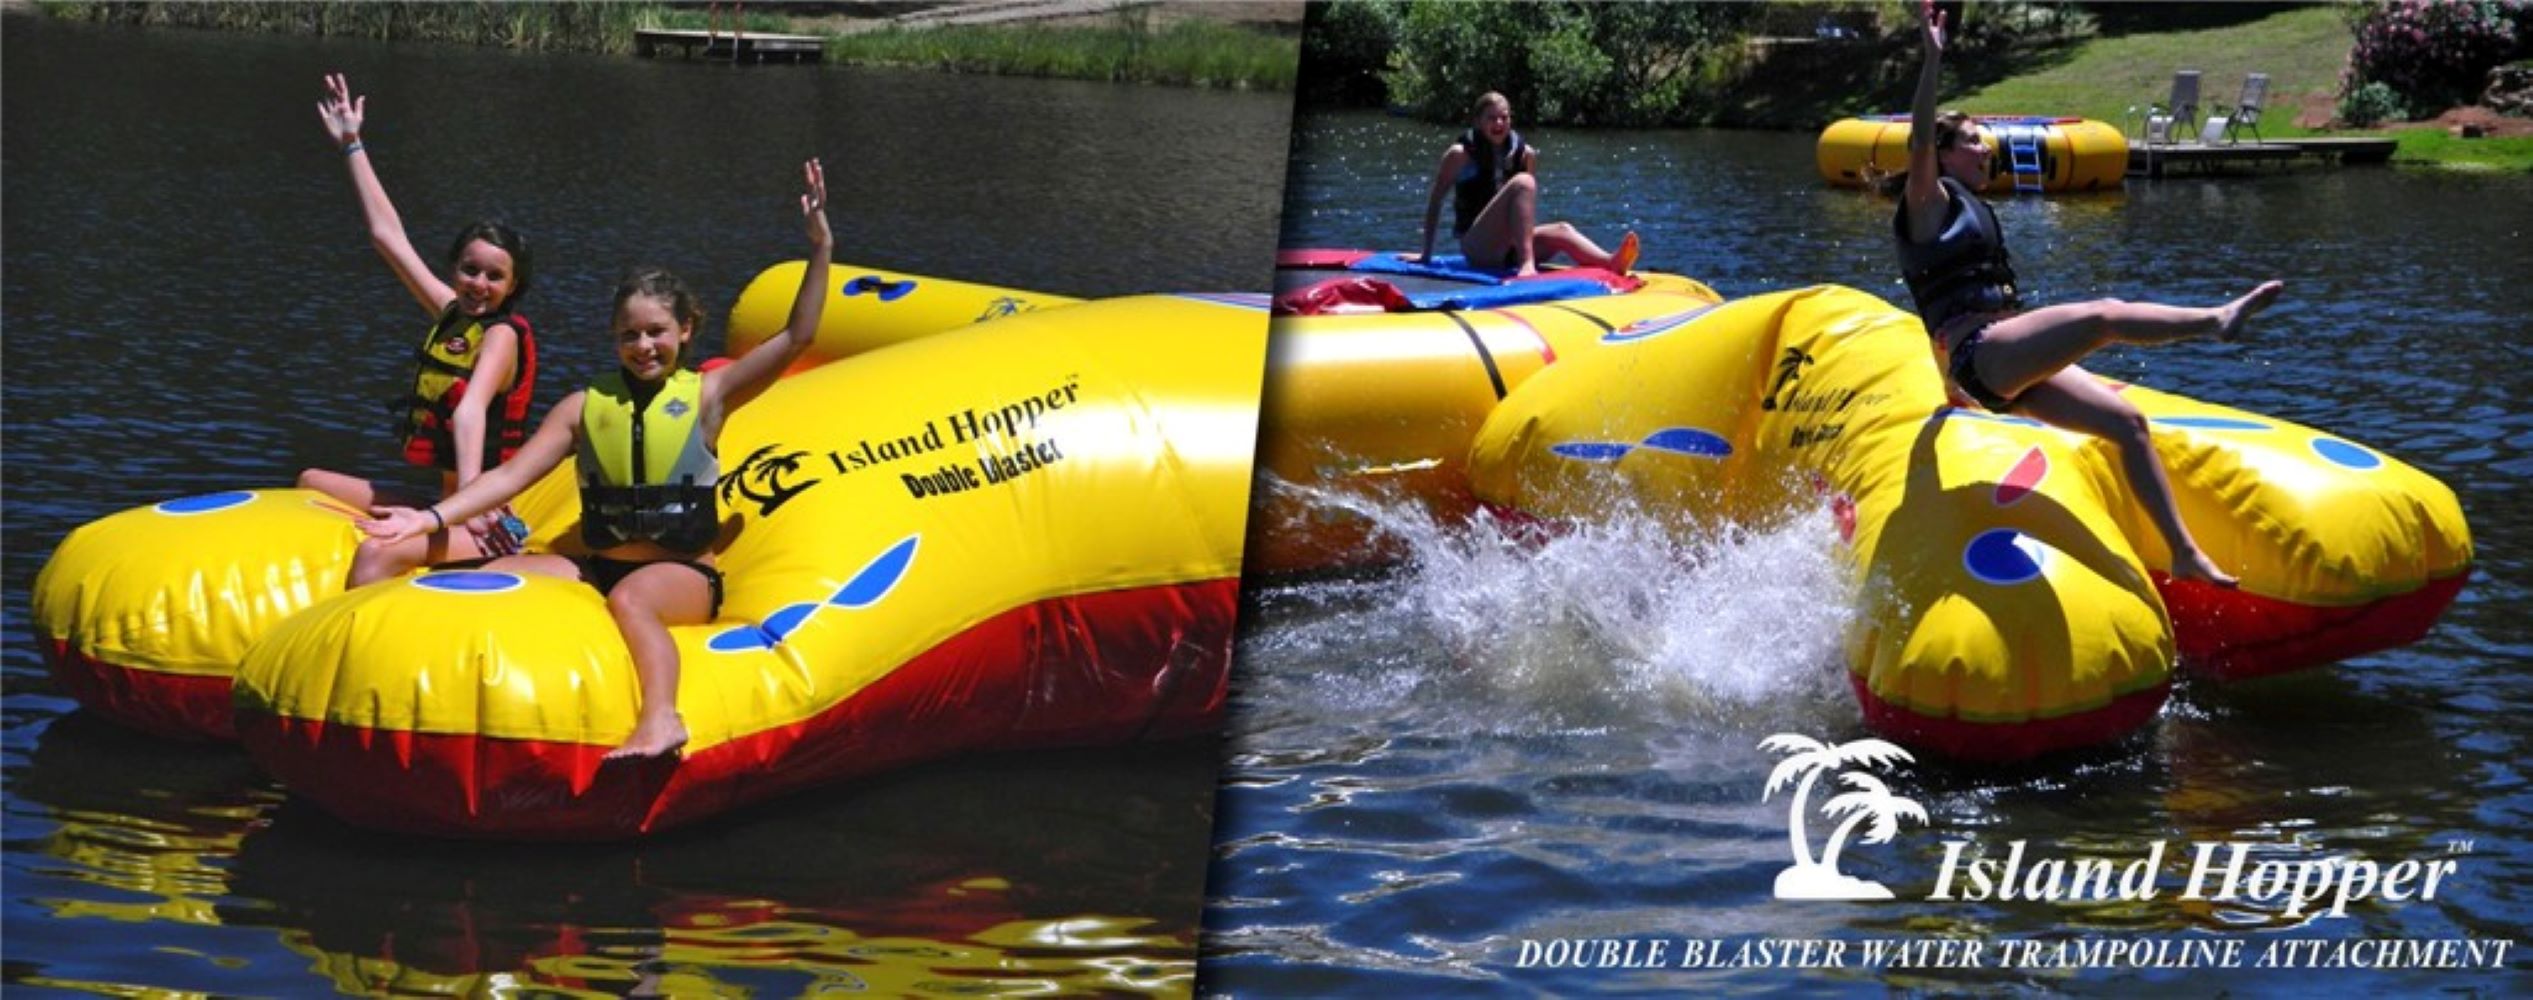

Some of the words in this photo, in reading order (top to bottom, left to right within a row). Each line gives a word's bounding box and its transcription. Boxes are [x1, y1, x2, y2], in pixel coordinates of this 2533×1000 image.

[828, 420, 945, 475] Island
[946, 381, 1080, 445] Hopper
[900, 463, 981, 499] Double
